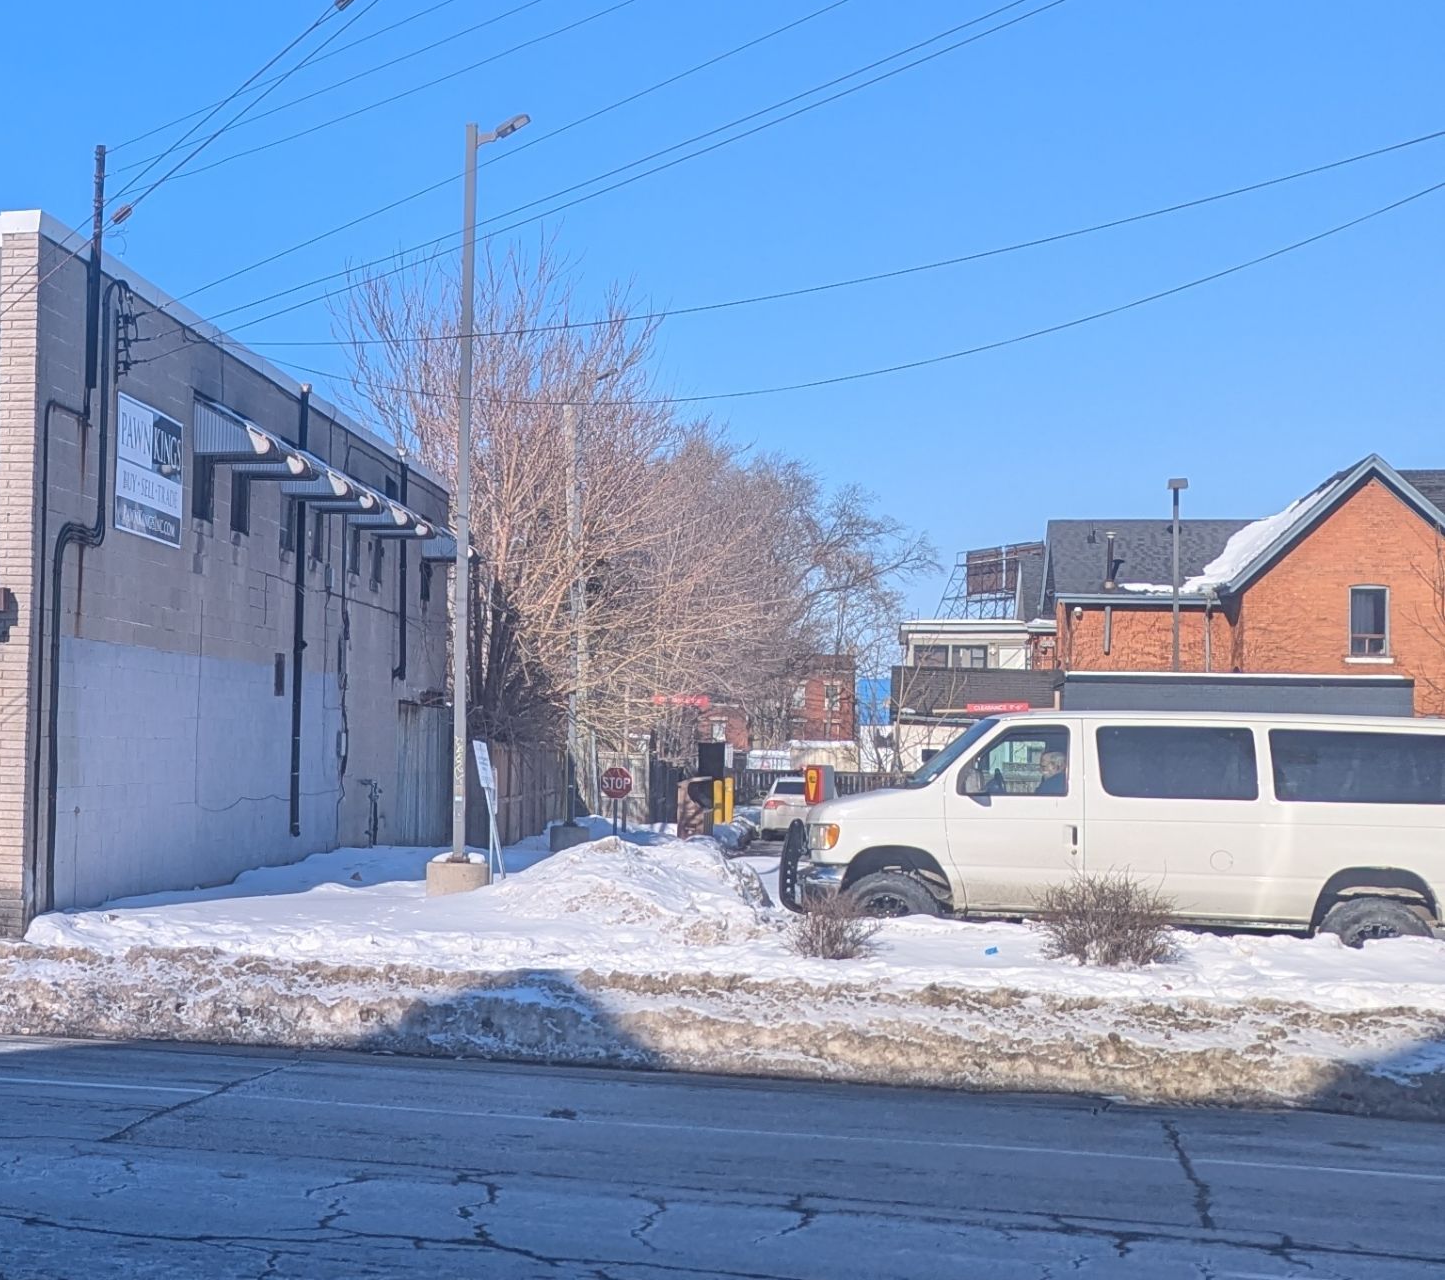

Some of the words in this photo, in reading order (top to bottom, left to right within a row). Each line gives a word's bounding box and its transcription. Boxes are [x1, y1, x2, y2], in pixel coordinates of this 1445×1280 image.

[121, 412, 152, 456] PAWN
[154, 426, 182, 471] KINGS
[141, 477, 155, 500] SELL
[602, 776, 631, 790] STOP
